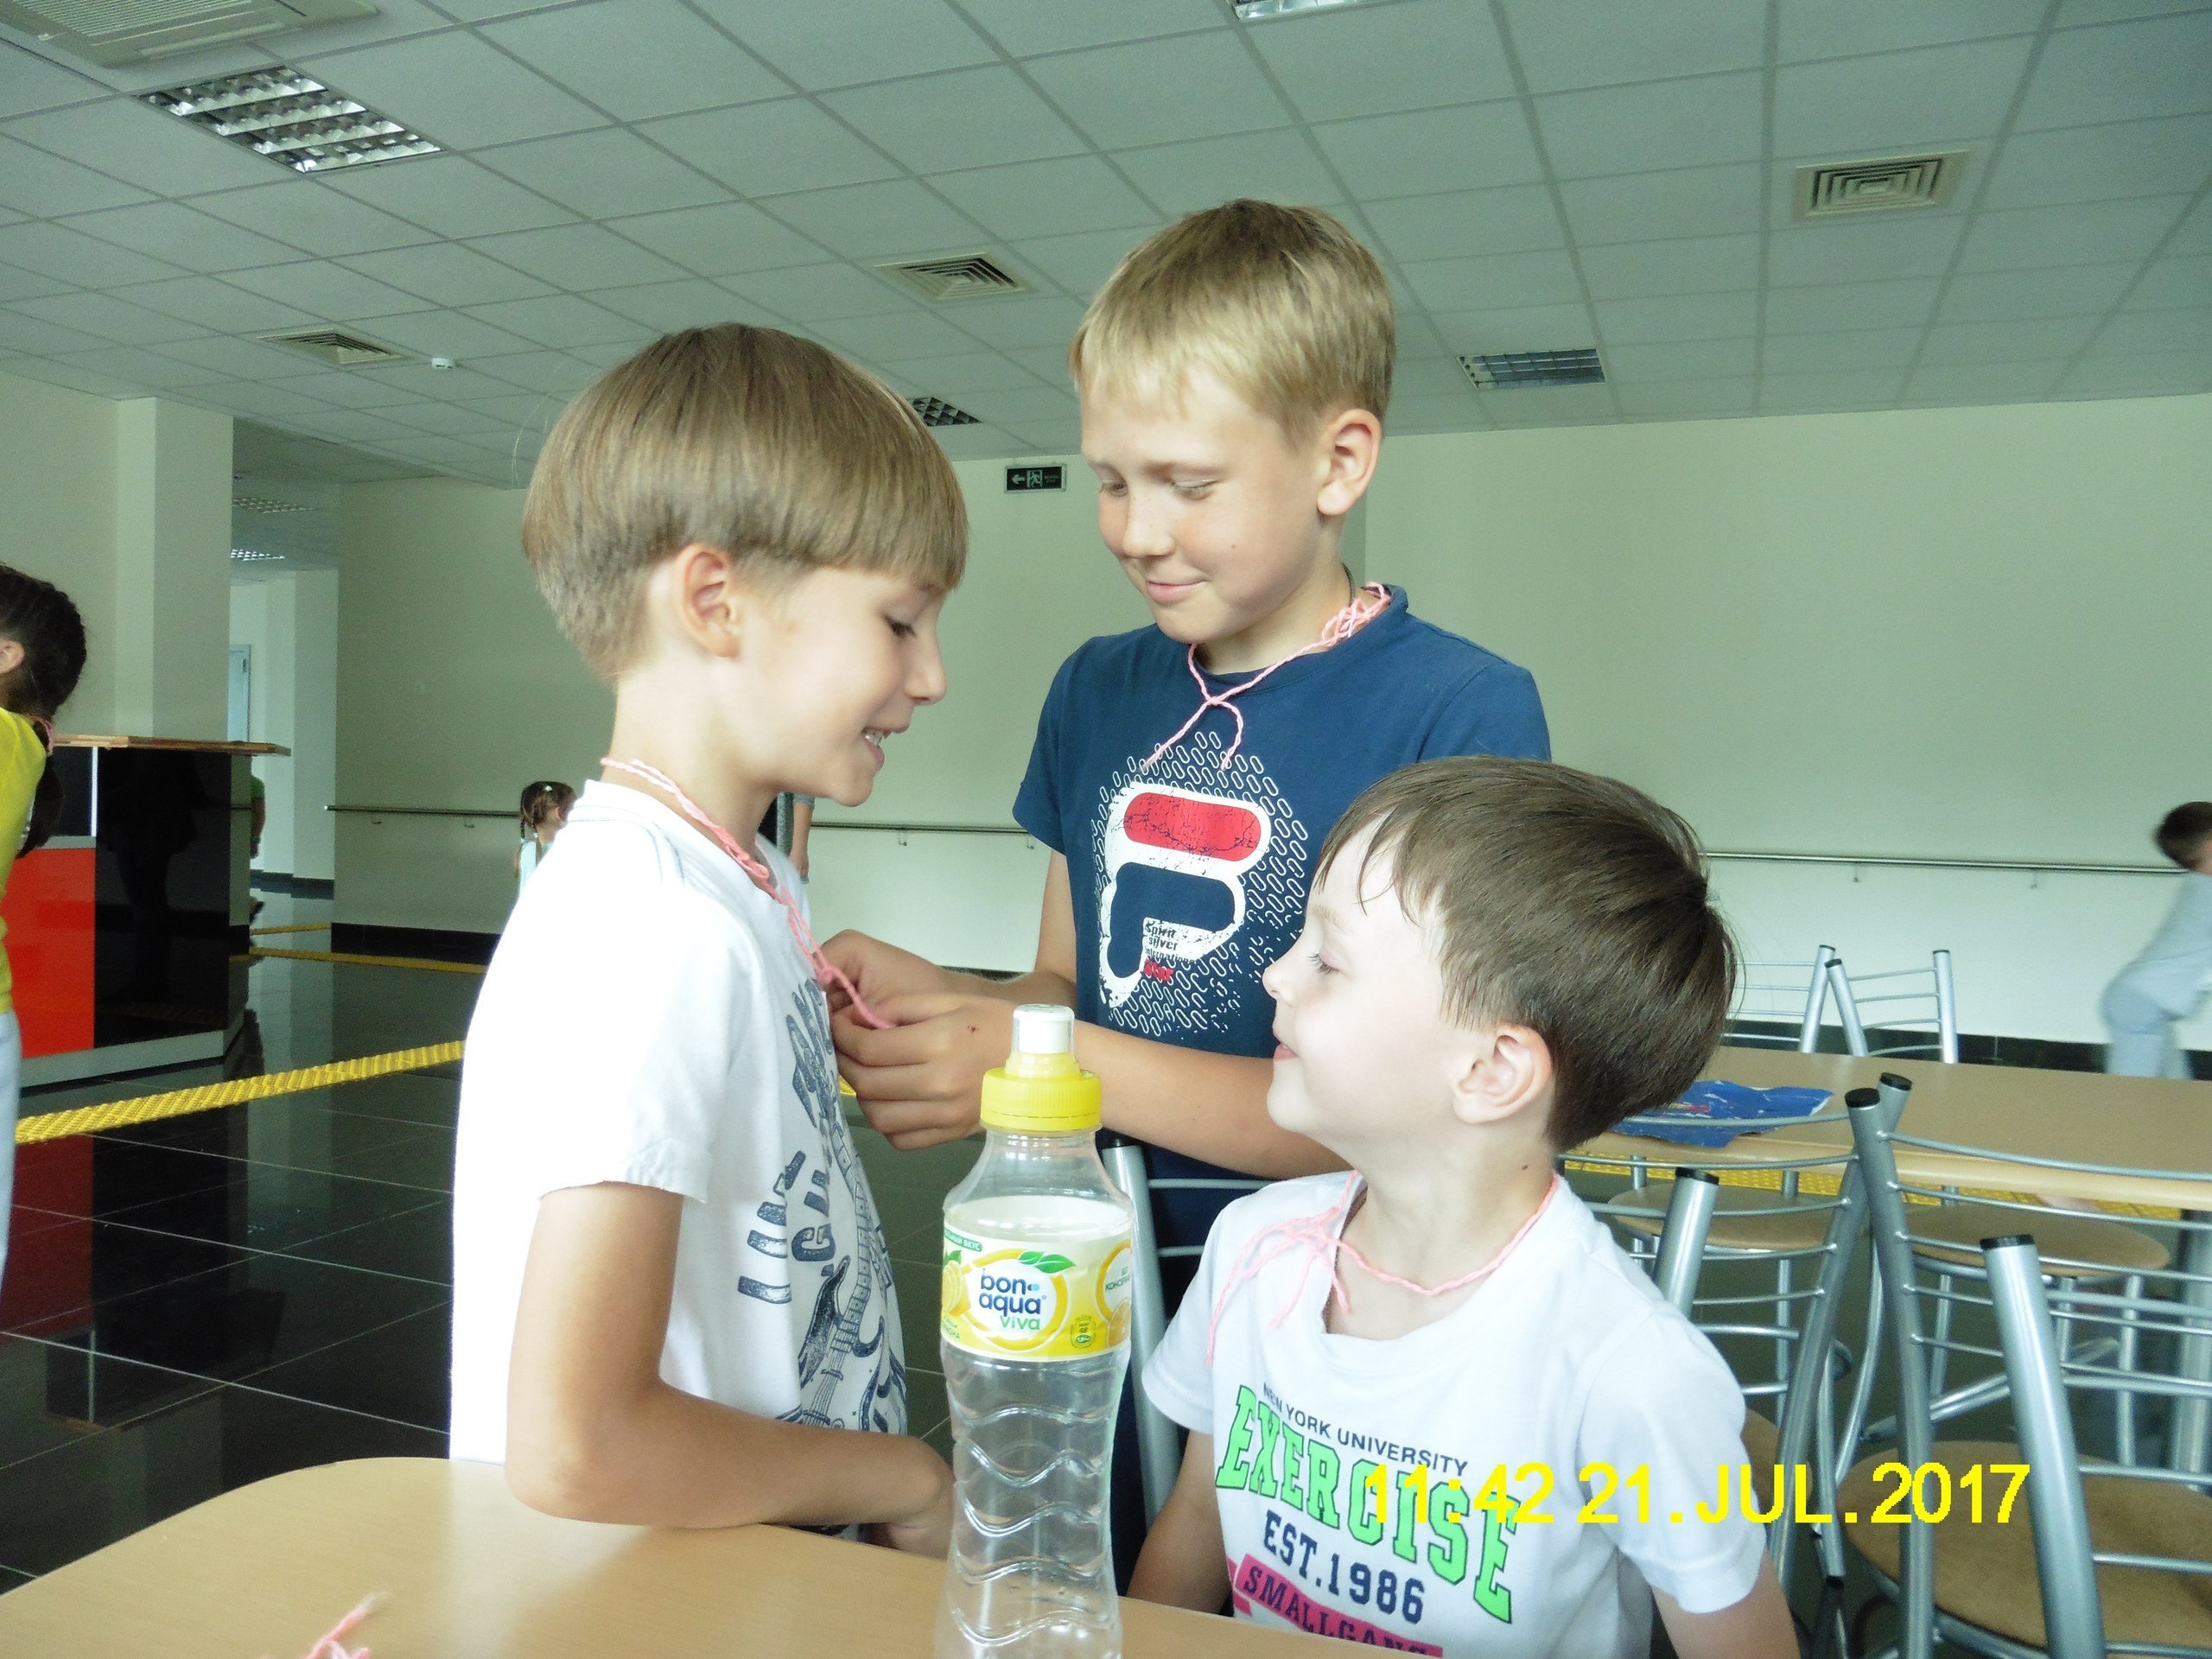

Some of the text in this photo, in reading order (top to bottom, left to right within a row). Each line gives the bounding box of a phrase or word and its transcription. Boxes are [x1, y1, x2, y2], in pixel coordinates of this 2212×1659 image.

[979, 1294, 1041, 1317] aqua
[1000, 1314, 1040, 1331] viva
[1286, 1403, 1332, 1440] YORK
[1338, 1427, 1469, 1478] UNIVERSITY
[1215, 1384, 1521, 1624] EXERCISE
